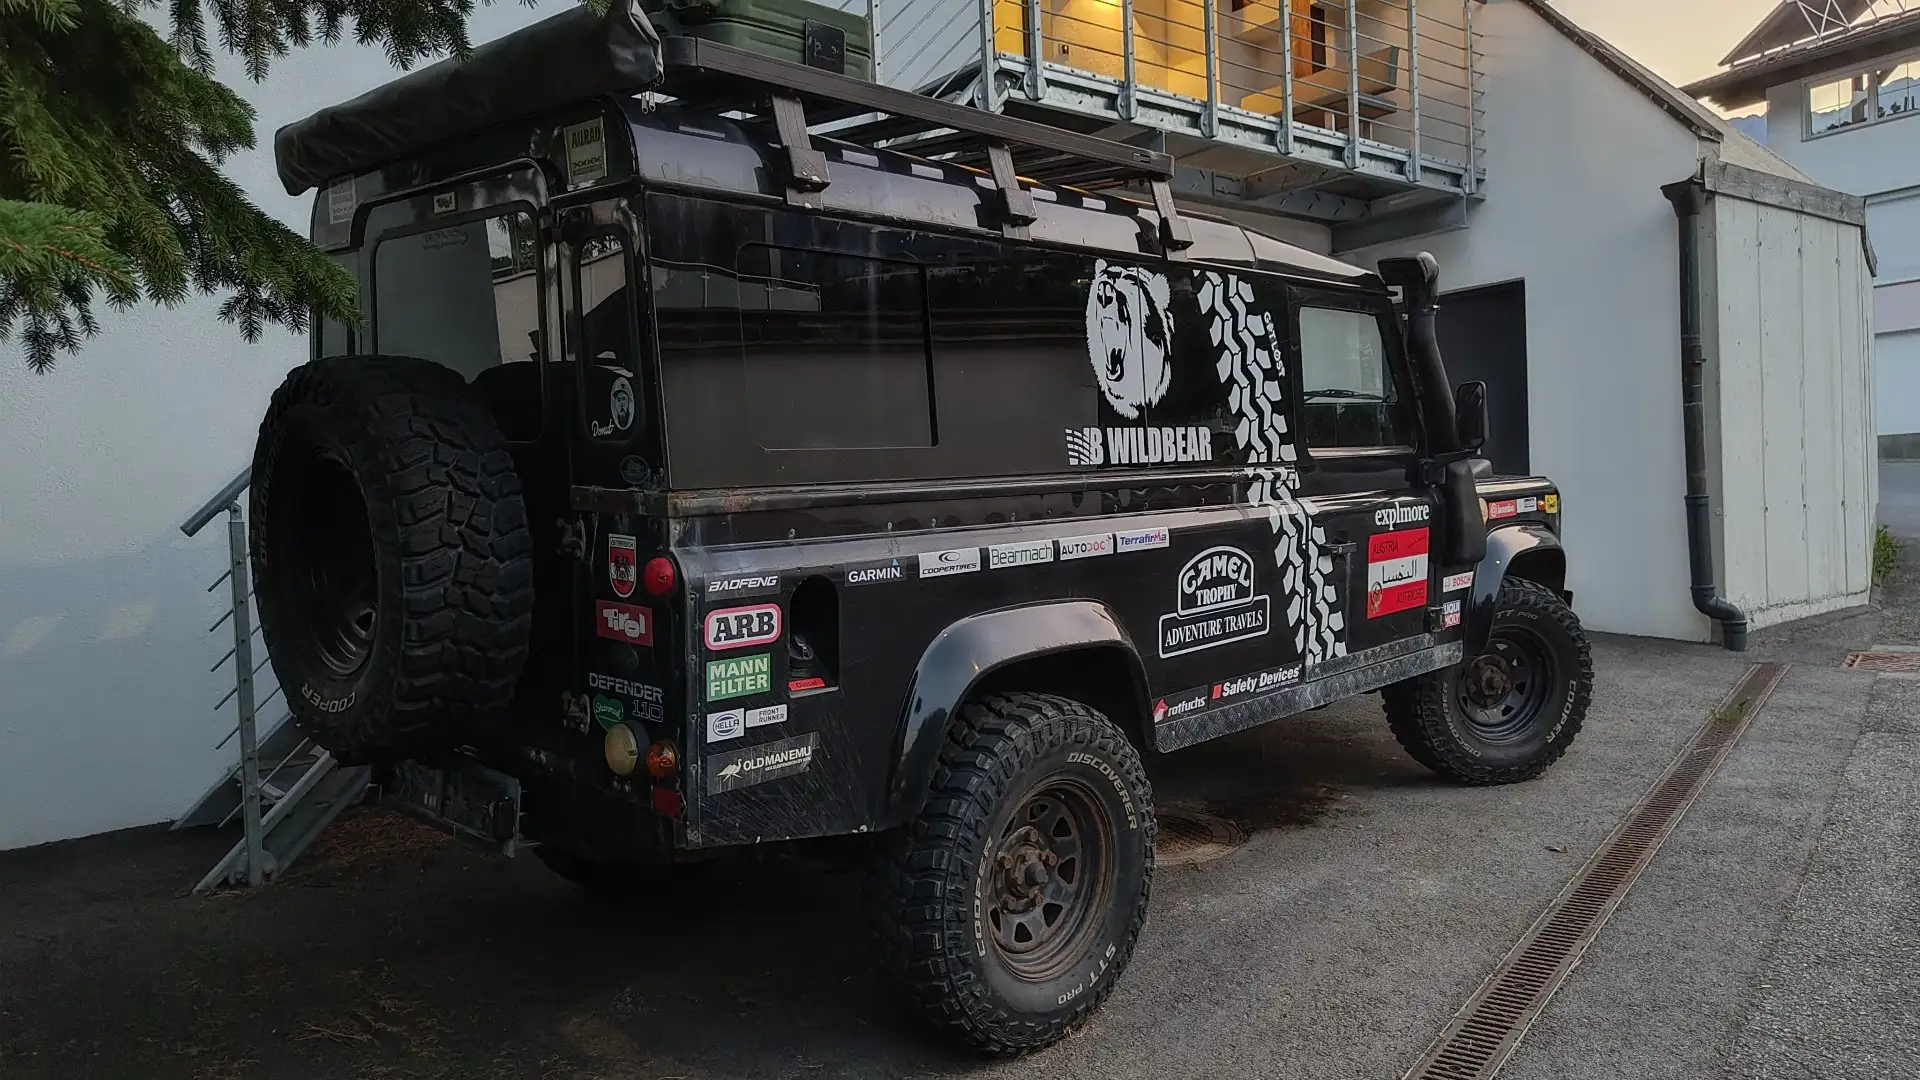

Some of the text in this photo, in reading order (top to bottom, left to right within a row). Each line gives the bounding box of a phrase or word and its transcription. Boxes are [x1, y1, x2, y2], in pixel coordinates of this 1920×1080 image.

[1106, 426, 1212, 464] WILDBEAR
[1375, 502, 1430, 530] explmore
[991, 544, 1052, 567] Bearmach
[1061, 540, 1106, 556] AUTODOC
[708, 575, 778, 592] BAOFENG
[848, 567, 901, 583] GARMIN
[1183, 555, 1249, 594] CAMEL
[1452, 574, 1472, 587] BOSCH
[1196, 583, 1238, 605] TROPHY
[602, 607, 646, 637] Tirol
[714, 612, 775, 643] ARB
[1517, 611, 1539, 620] PRO
[1165, 610, 1263, 647] ADVENTURE TRAVELS
[711, 658, 768, 679] MANN
[589, 672, 663, 704] DEFENDER
[710, 674, 768, 697] FILTER
[1222, 667, 1300, 697] Safety Devices
[301, 682, 356, 713] COOPER
[1168, 697, 1206, 716] rotfuchs
[632, 699, 664, 723] 110
[758, 708, 780, 716] FRONT
[758, 713, 785, 723] RUNNER
[1547, 679, 1577, 743] COOPER
[715, 719, 740, 730] HELLA
[743, 746, 811, 771] OLD MAN EMU
[1066, 751, 1138, 830] DISCOVERER
[1058, 944, 1117, 1006] STT PRO
